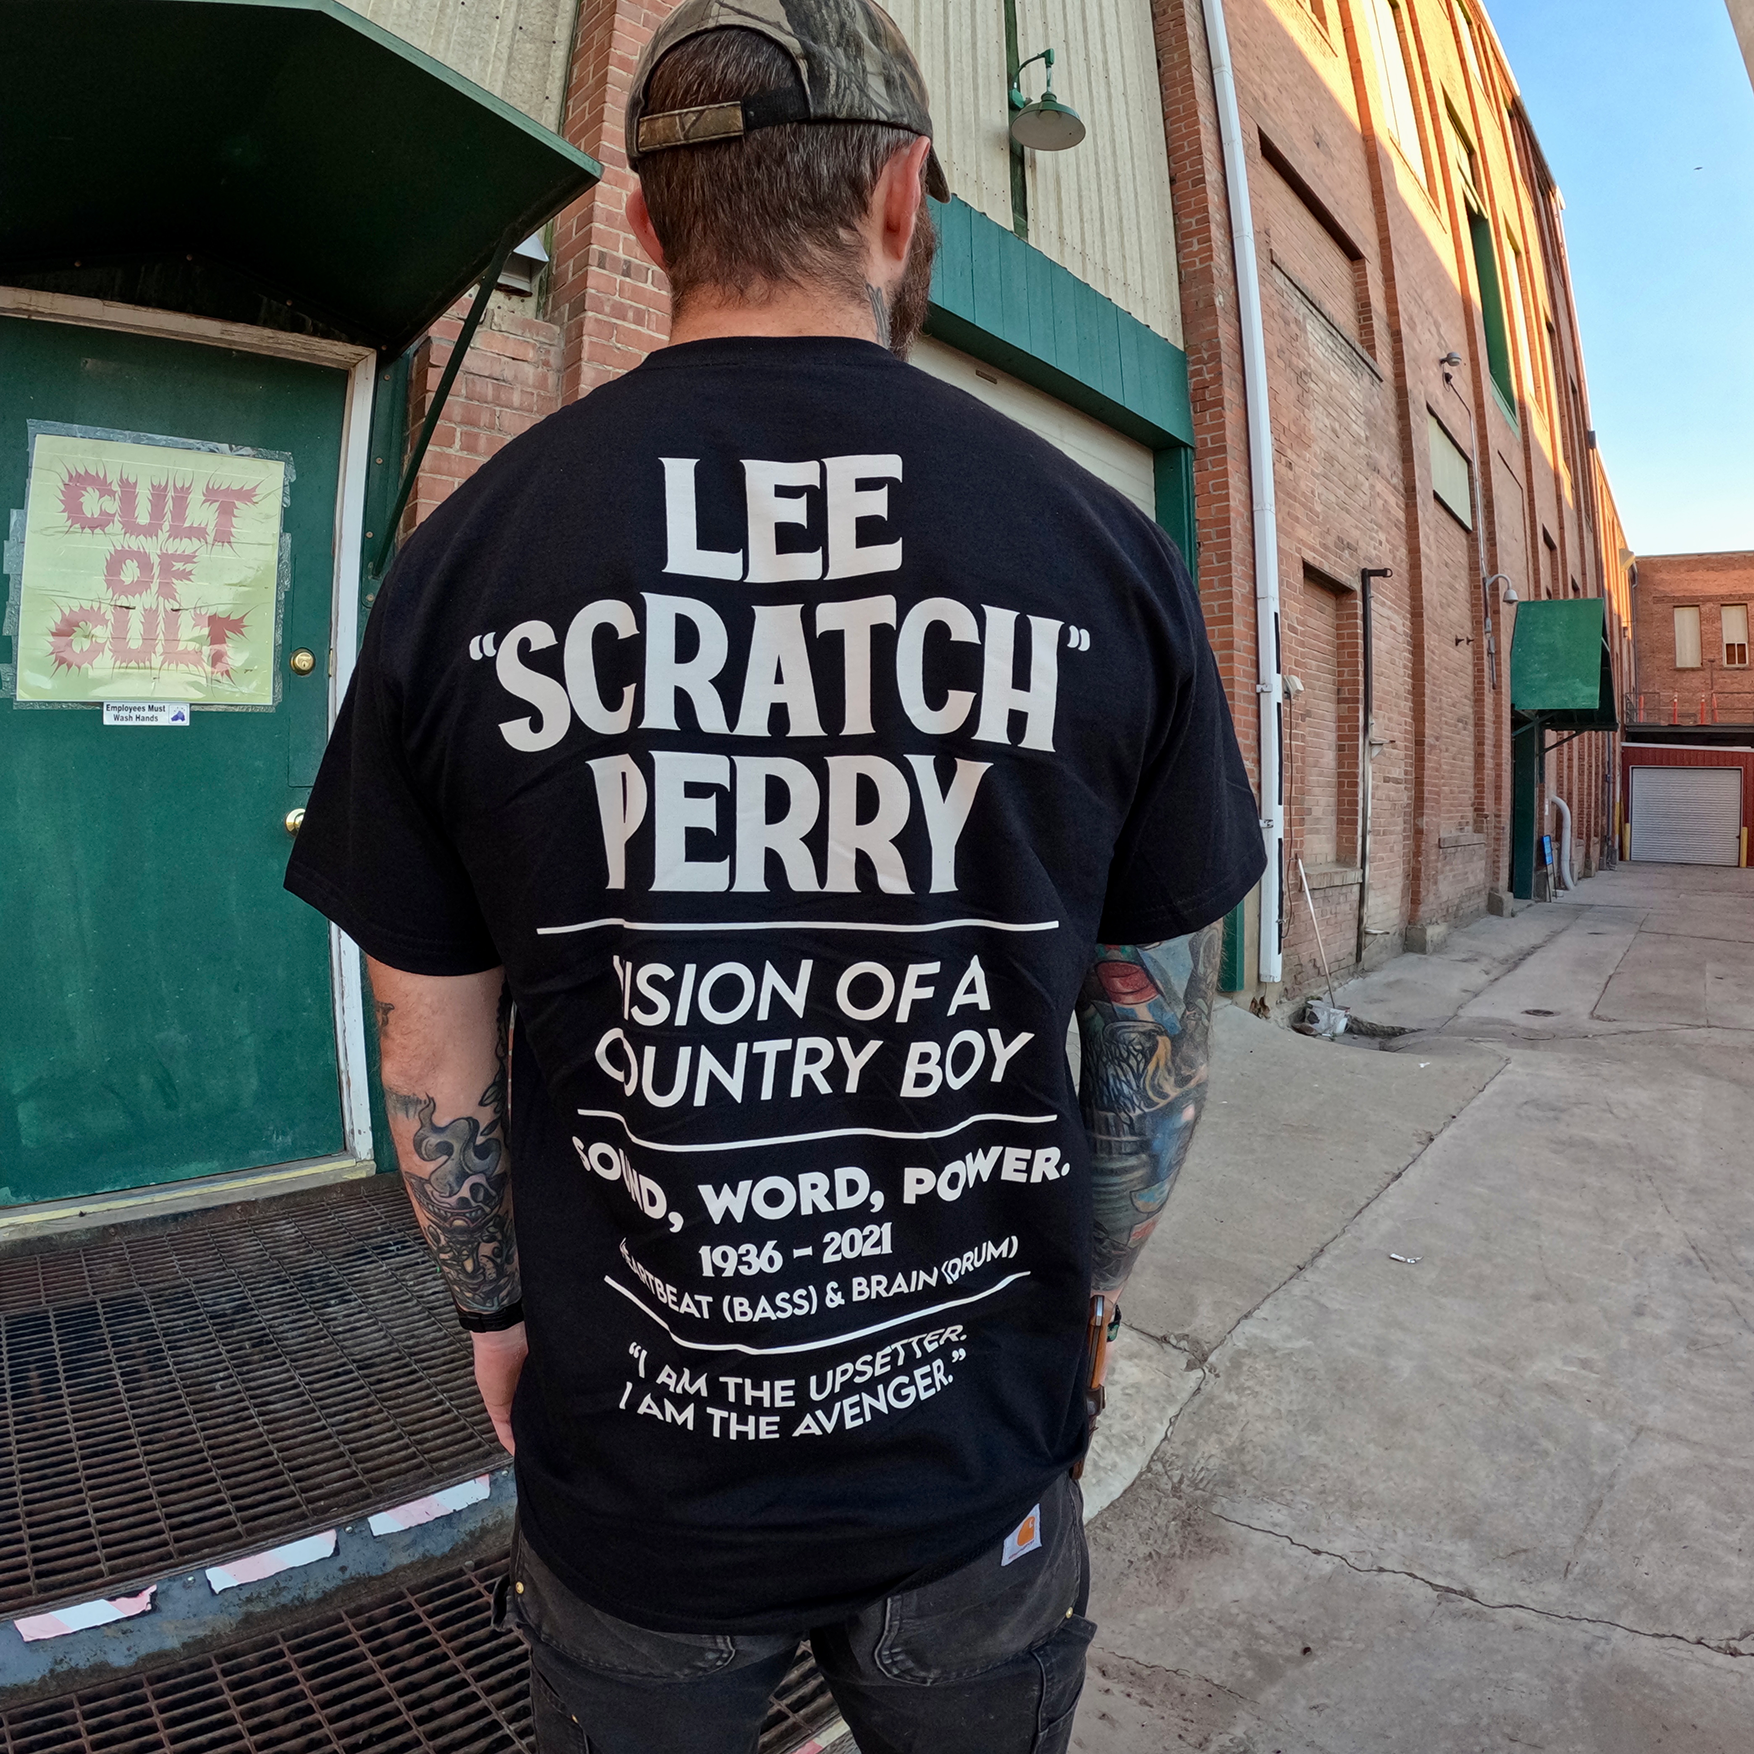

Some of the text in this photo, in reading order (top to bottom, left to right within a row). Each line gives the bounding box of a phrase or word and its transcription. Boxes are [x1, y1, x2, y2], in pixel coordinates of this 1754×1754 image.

[56, 459, 267, 554] CULT
[657, 454, 903, 583] LEE
[102, 545, 206, 606] OF
[46, 599, 255, 692] CULT
[468, 592, 1091, 753] “SCRATCH”
[106, 703, 166, 714] Employees Must
[113, 714, 158, 722] Wash Hands
[585, 751, 994, 894] PERRY
[836, 959, 941, 1023] OF
[946, 954, 991, 1017] A
[900, 1028, 1035, 1098] BOY
[697, 1166, 885, 1225] WORD,
[903, 1145, 1071, 1202] POWER.
[698, 1240, 784, 1277] 1936
[822, 1221, 893, 1264] 2021
[722, 1285, 818, 1323] (BASS)
[825, 1281, 846, 1309] &
[852, 1266, 938, 1302] BRAIN
[941, 1235, 1019, 1285] (DRUM)
[618, 1347, 967, 1441] I AM THE AVENGER.”
[628, 1324, 968, 1408] “I AM THE UPSETTER.
